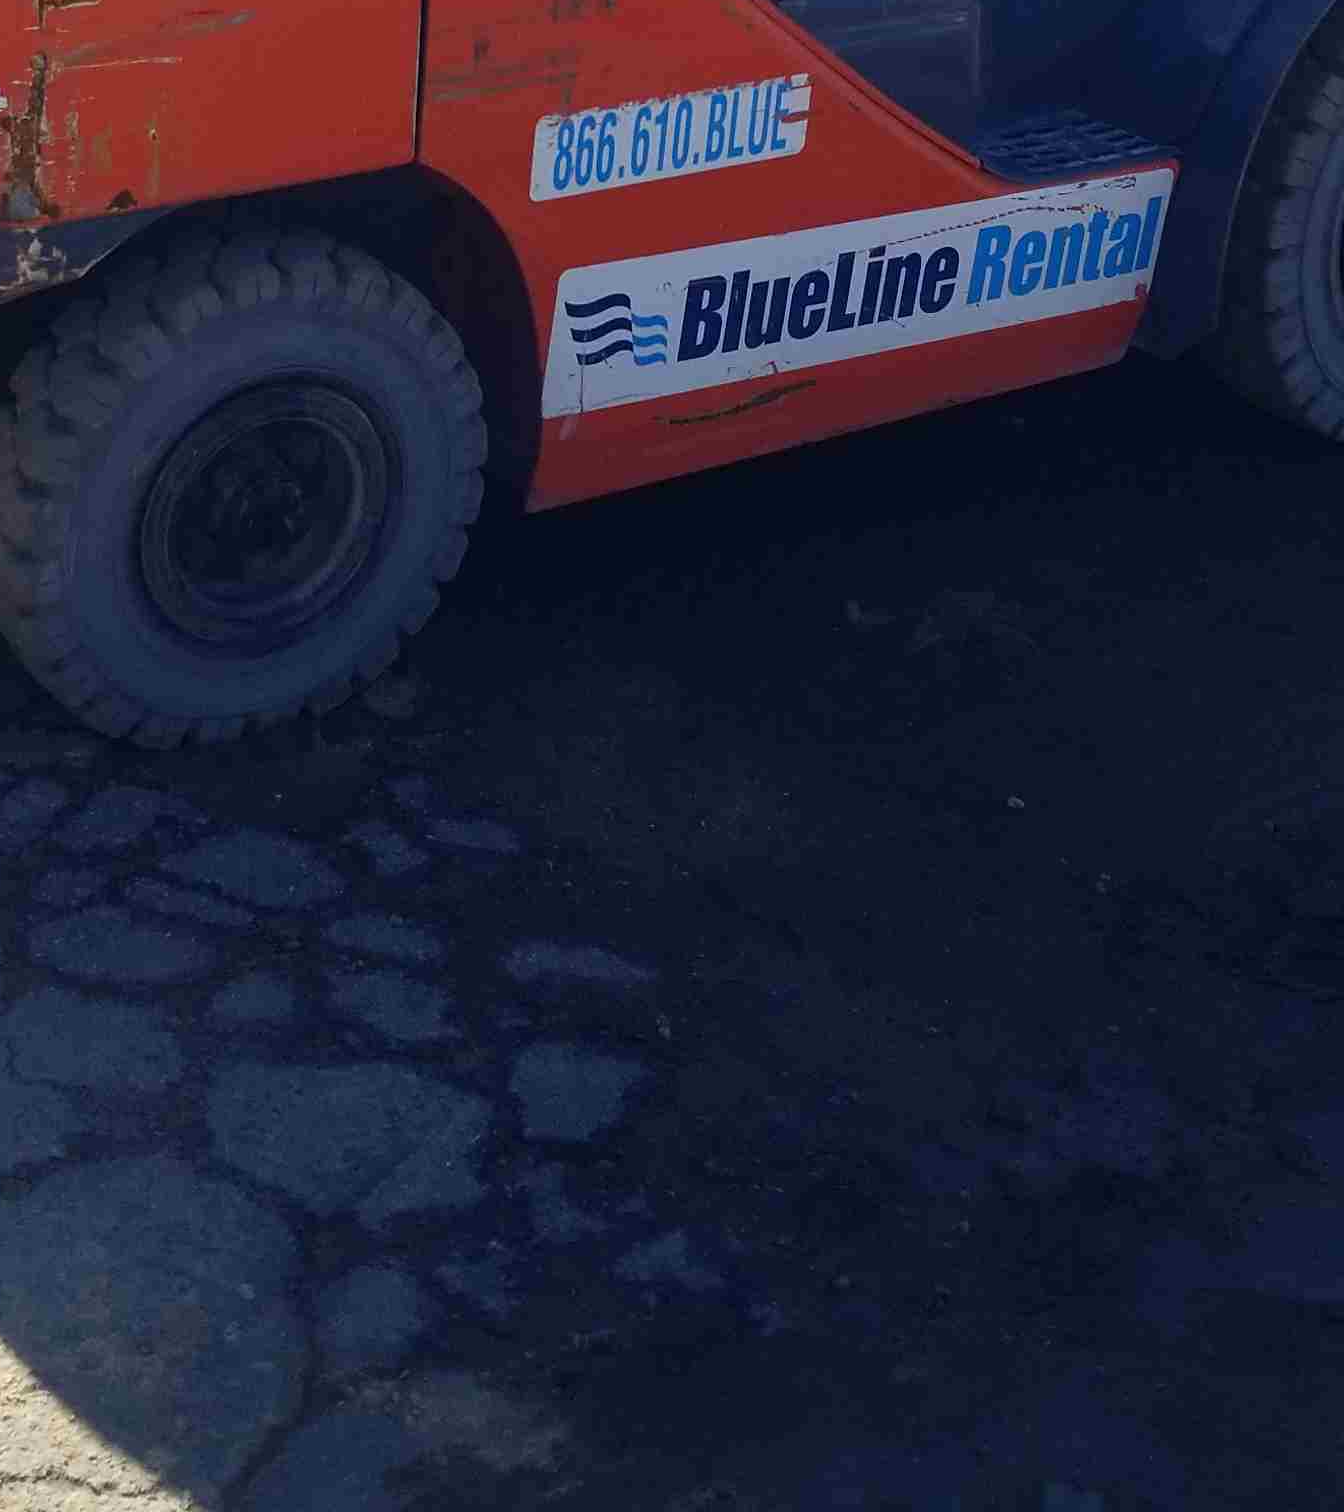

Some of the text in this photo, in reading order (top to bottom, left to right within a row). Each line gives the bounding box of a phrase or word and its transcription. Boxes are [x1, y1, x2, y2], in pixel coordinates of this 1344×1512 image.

[552, 80, 792, 191] 866.610.BLUE
[676, 196, 1163, 362] BlueLine Rental
